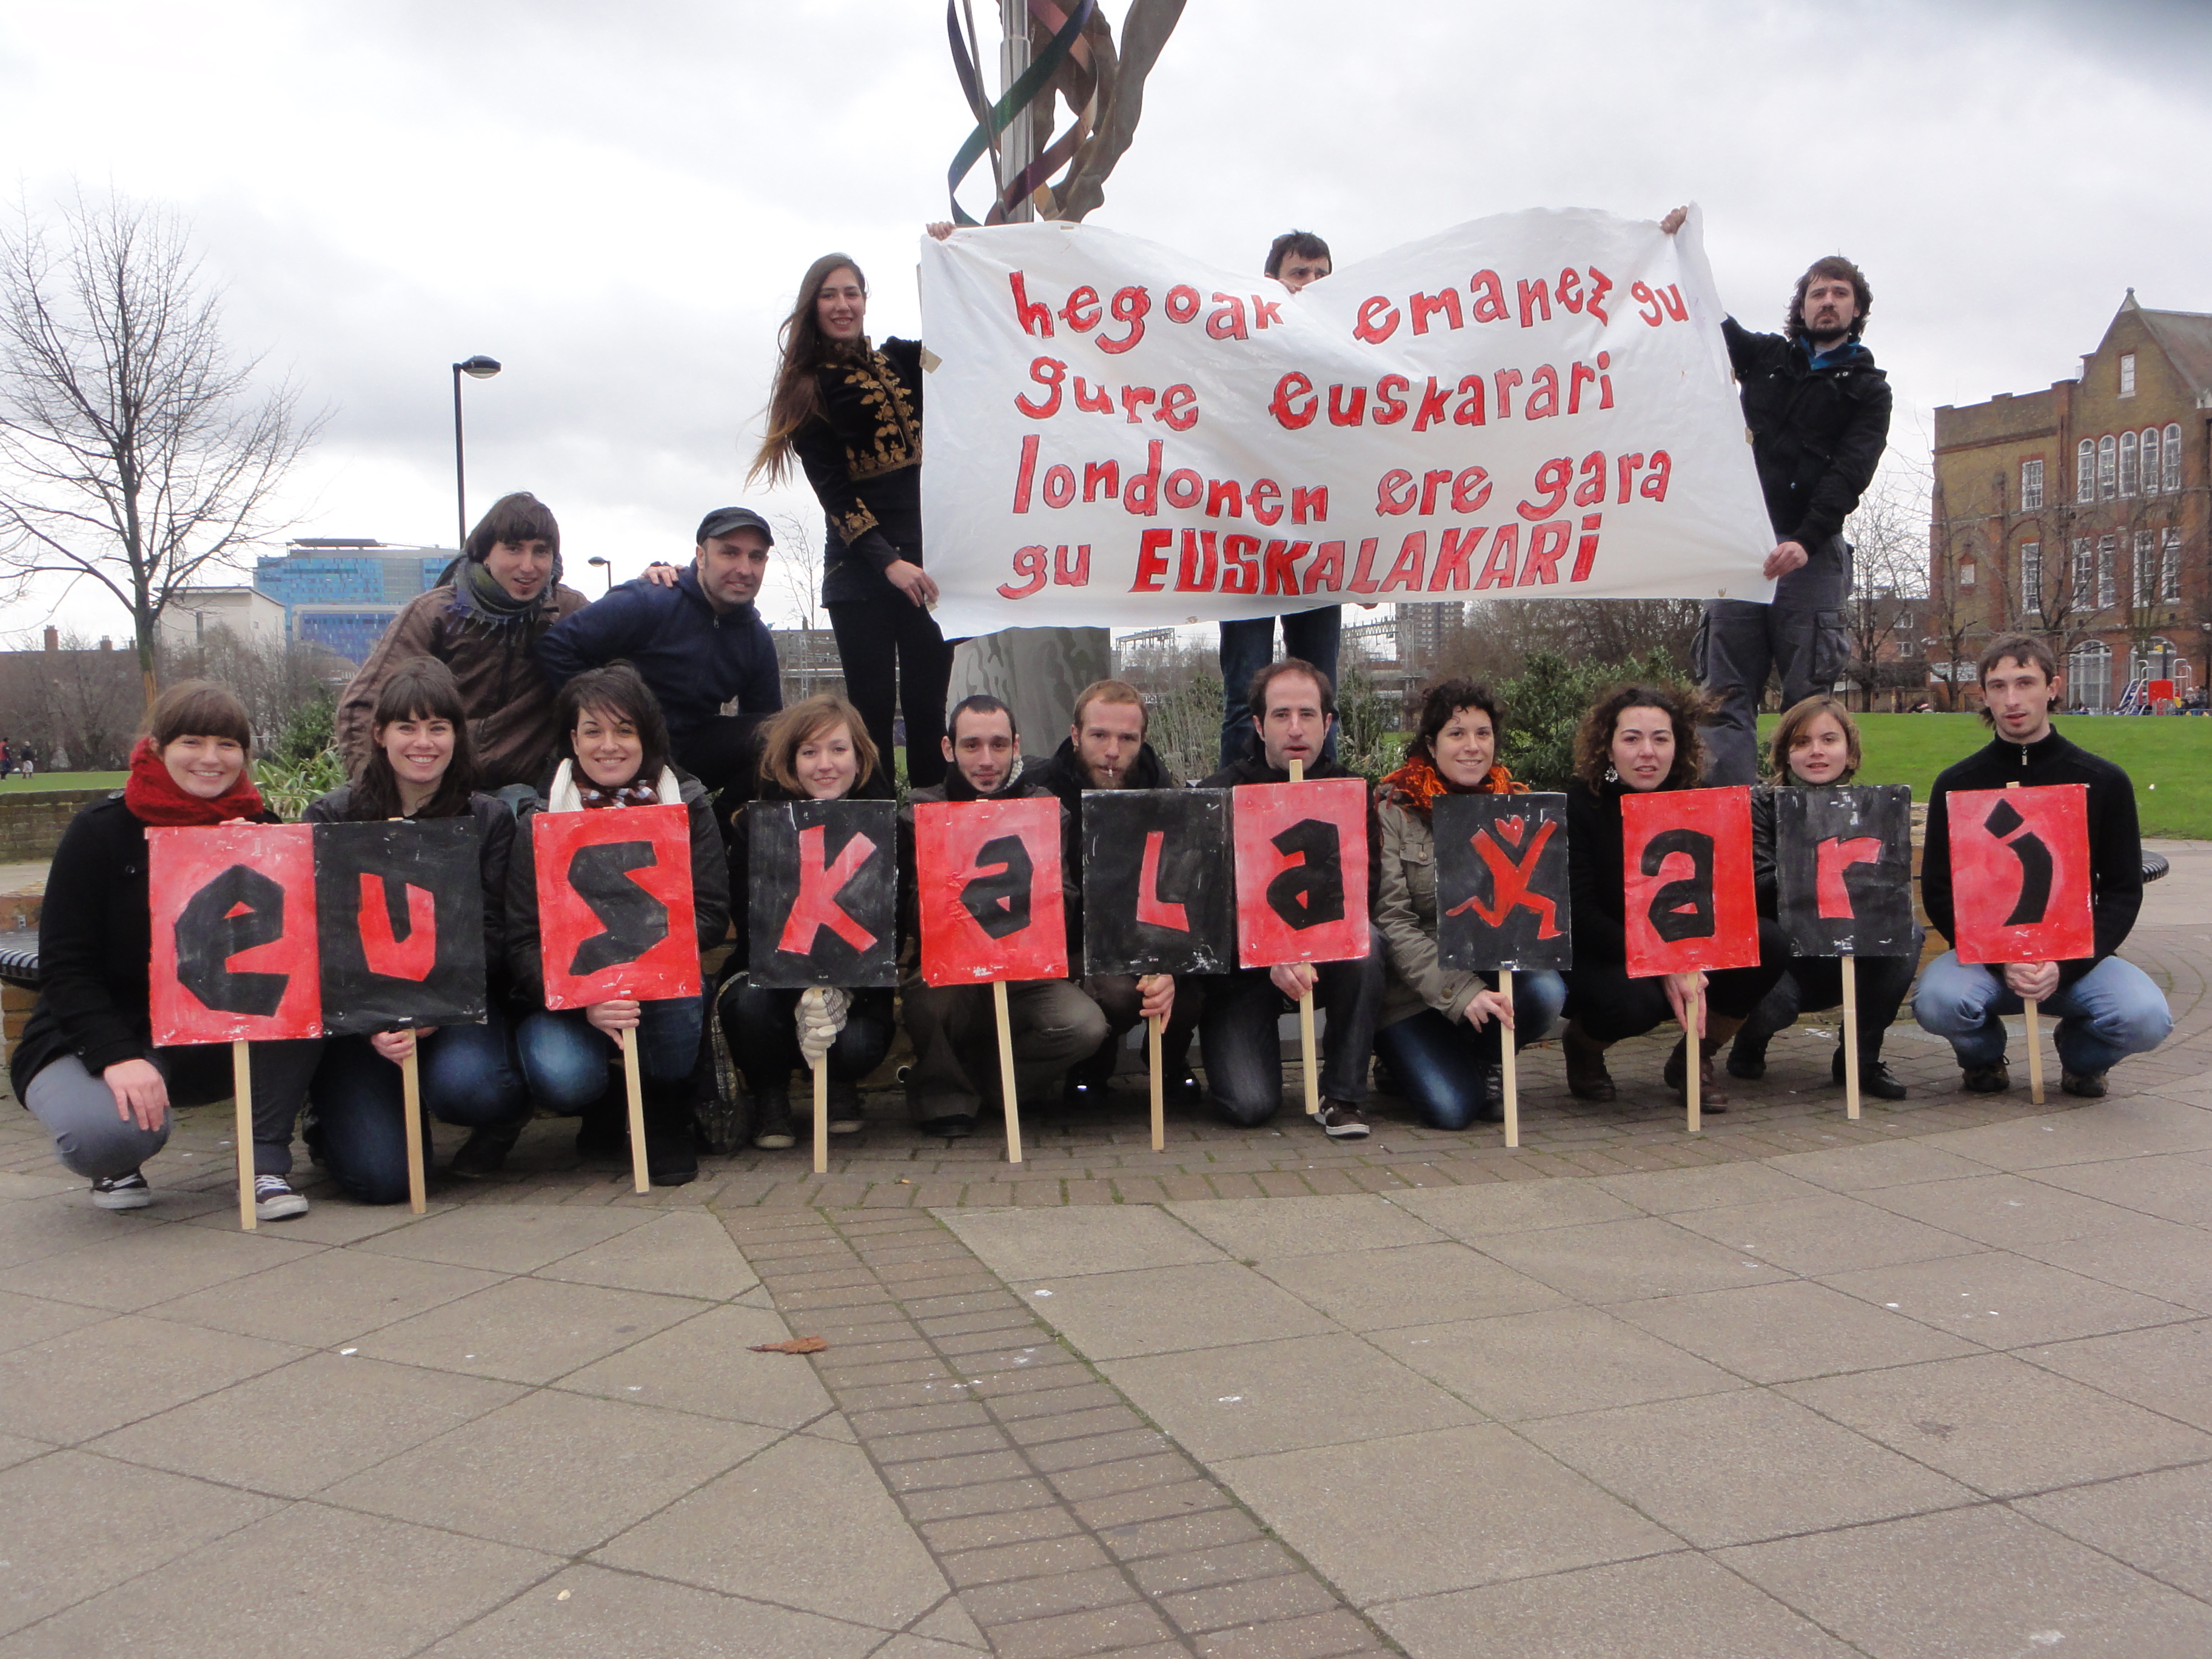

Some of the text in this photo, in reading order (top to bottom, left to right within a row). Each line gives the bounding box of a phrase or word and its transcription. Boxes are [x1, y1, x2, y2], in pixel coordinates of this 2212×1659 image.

[1007, 263, 1692, 357] hegoak emanez gu
[1011, 349, 1613, 434] gure euskarari
[1011, 432, 1674, 528] londonen ere gara
[995, 538, 1092, 602] gu
